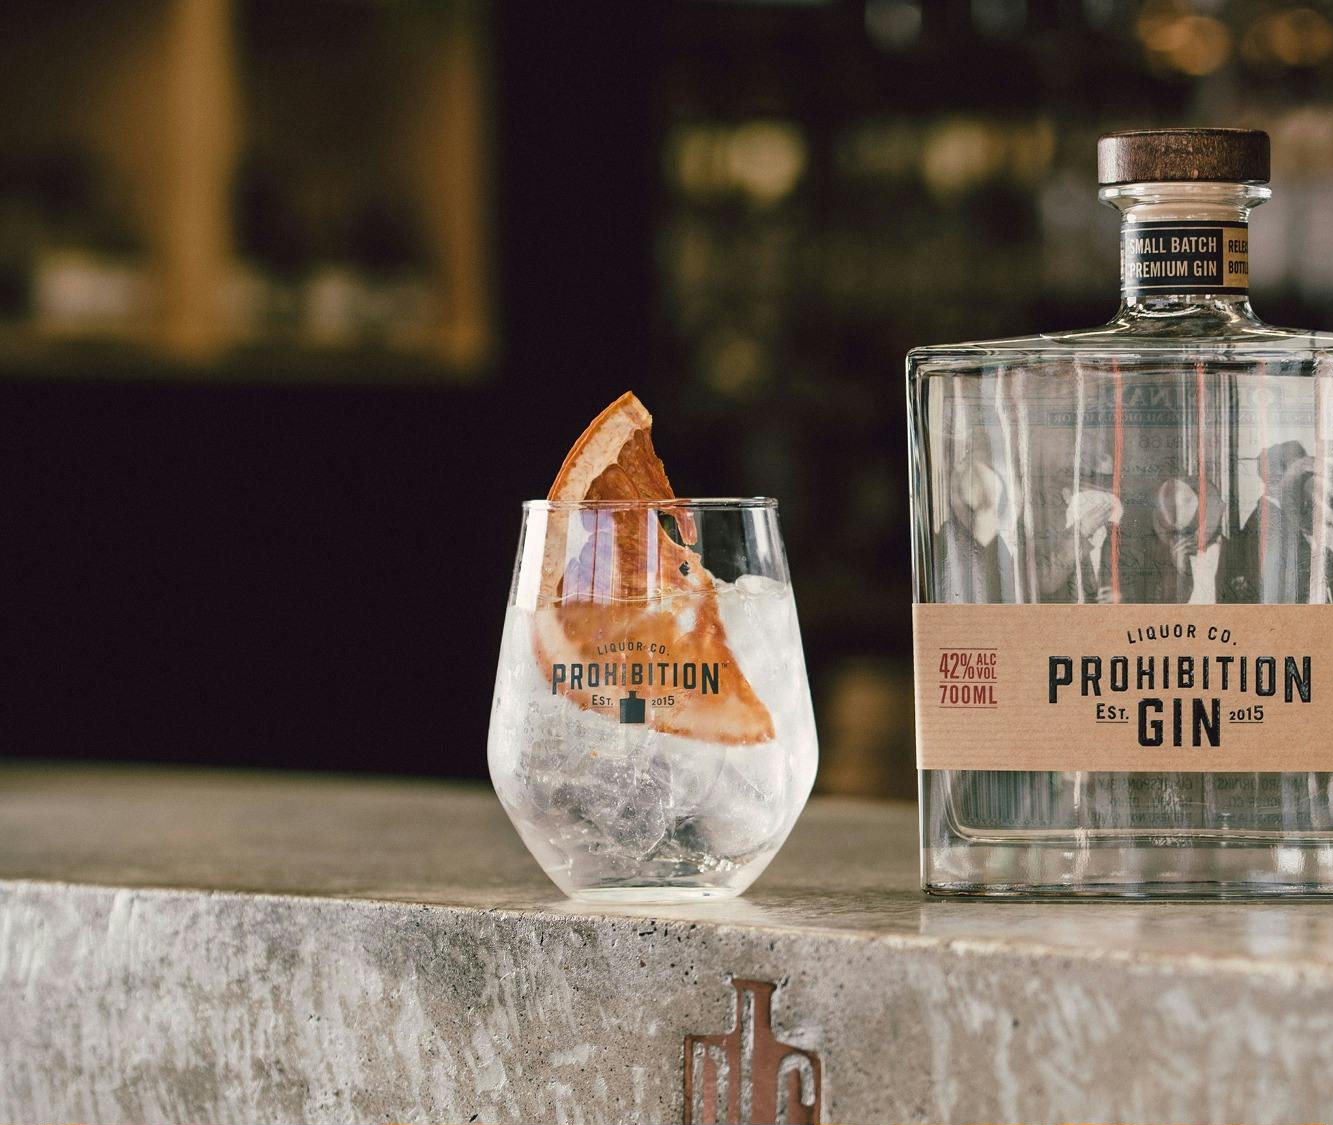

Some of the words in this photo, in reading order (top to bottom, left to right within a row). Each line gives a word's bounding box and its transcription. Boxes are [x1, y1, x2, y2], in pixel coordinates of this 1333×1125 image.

[1129, 237, 1166, 255] SMALL
[1171, 236, 1217, 253] BATCH
[1129, 260, 1188, 278] PREMIUM
[1193, 260, 1217, 277] GIN
[1127, 624, 1196, 644] LIQUOR
[1207, 626, 1237, 646] CO.
[597, 641, 642, 656] LIQUOR
[650, 643, 669, 656] CO.
[939, 653, 975, 680] 42%
[976, 653, 997, 666] ALC
[976, 666, 998, 680] VOL
[552, 662, 719, 695] PROHIBITION
[1048, 655, 1312, 704] PROHIBITION
[651, 695, 675, 706] 2015
[939, 685, 998, 705] 700ML
[1137, 697, 1221, 747] GIN
[1229, 705, 1264, 721] 2015
